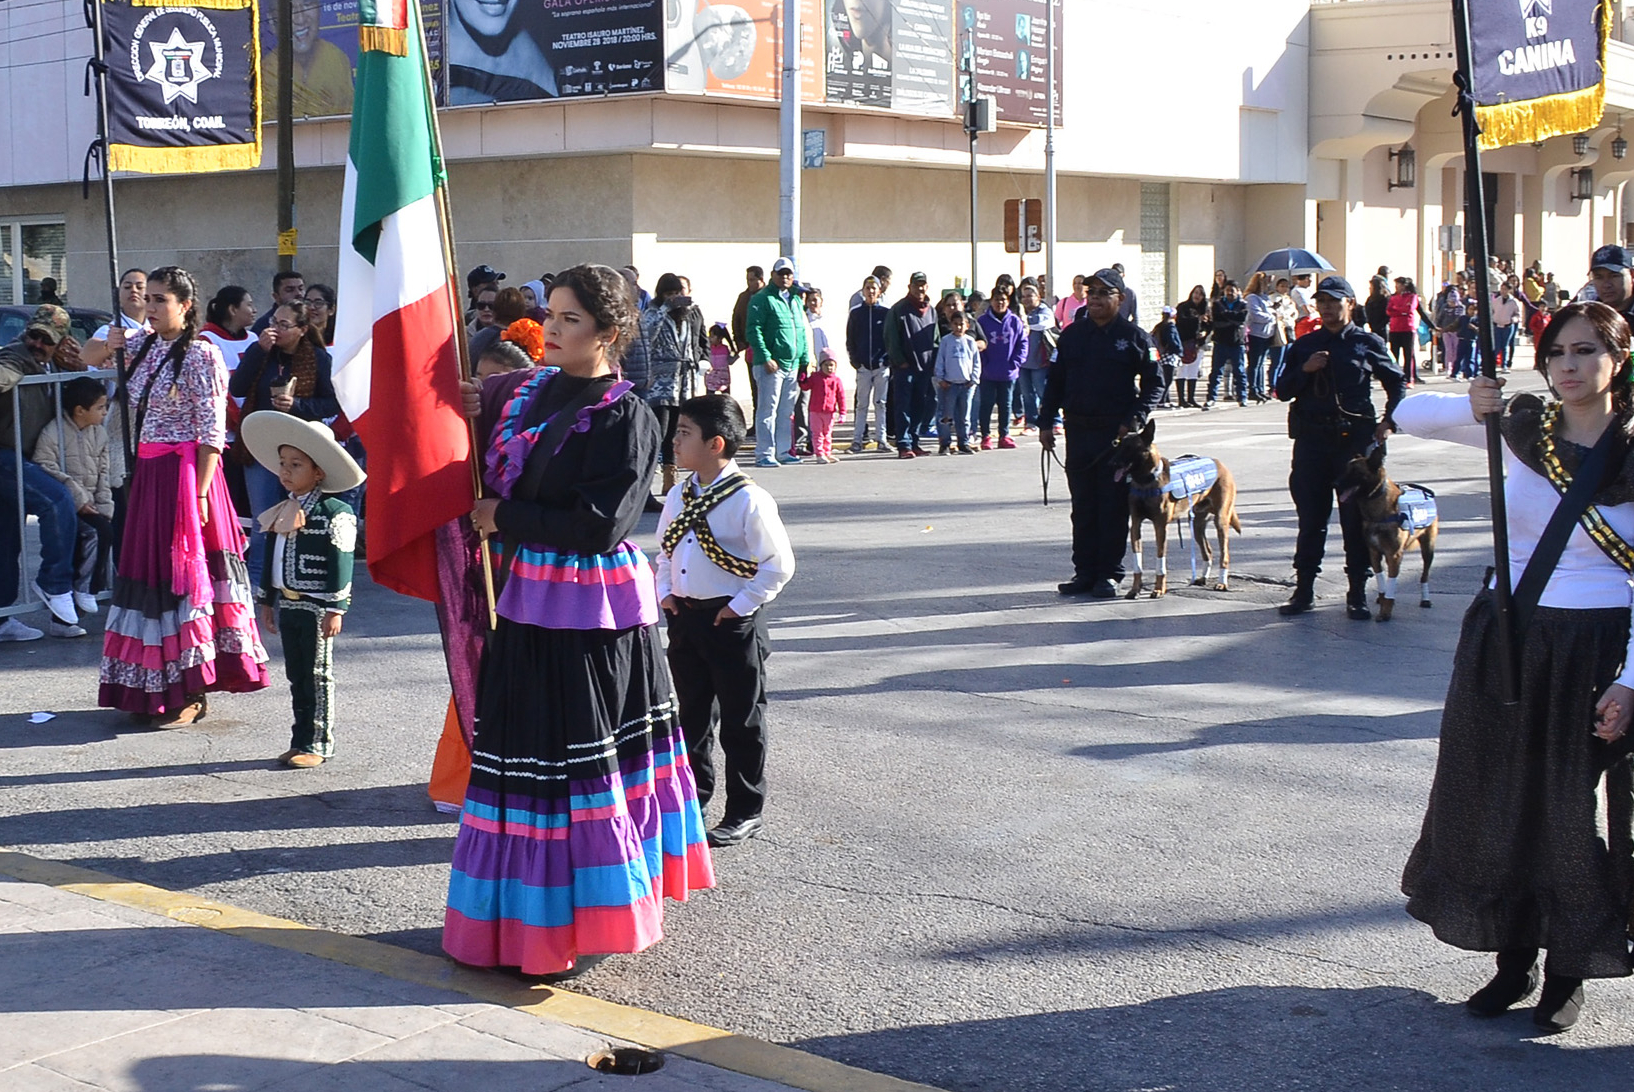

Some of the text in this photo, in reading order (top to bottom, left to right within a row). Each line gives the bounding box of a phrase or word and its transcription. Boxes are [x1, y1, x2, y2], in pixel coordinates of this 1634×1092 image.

[332, 2, 343, 11] de
[133, 10, 158, 39] GENERAL
[155, 7, 166, 16] DE
[336, 12, 359, 22] Teatr
[587, 30, 610, 39] ISAURO
[612, 26, 645, 35] MARTÍNEZ
[1525, 15, 1548, 38] K9
[552, 39, 591, 49] NOVIEMBRE
[622, 34, 640, 42] 20:00
[1497, 38, 1577, 76] CANINA
[136, 115, 190, 131] TORREÓN,
